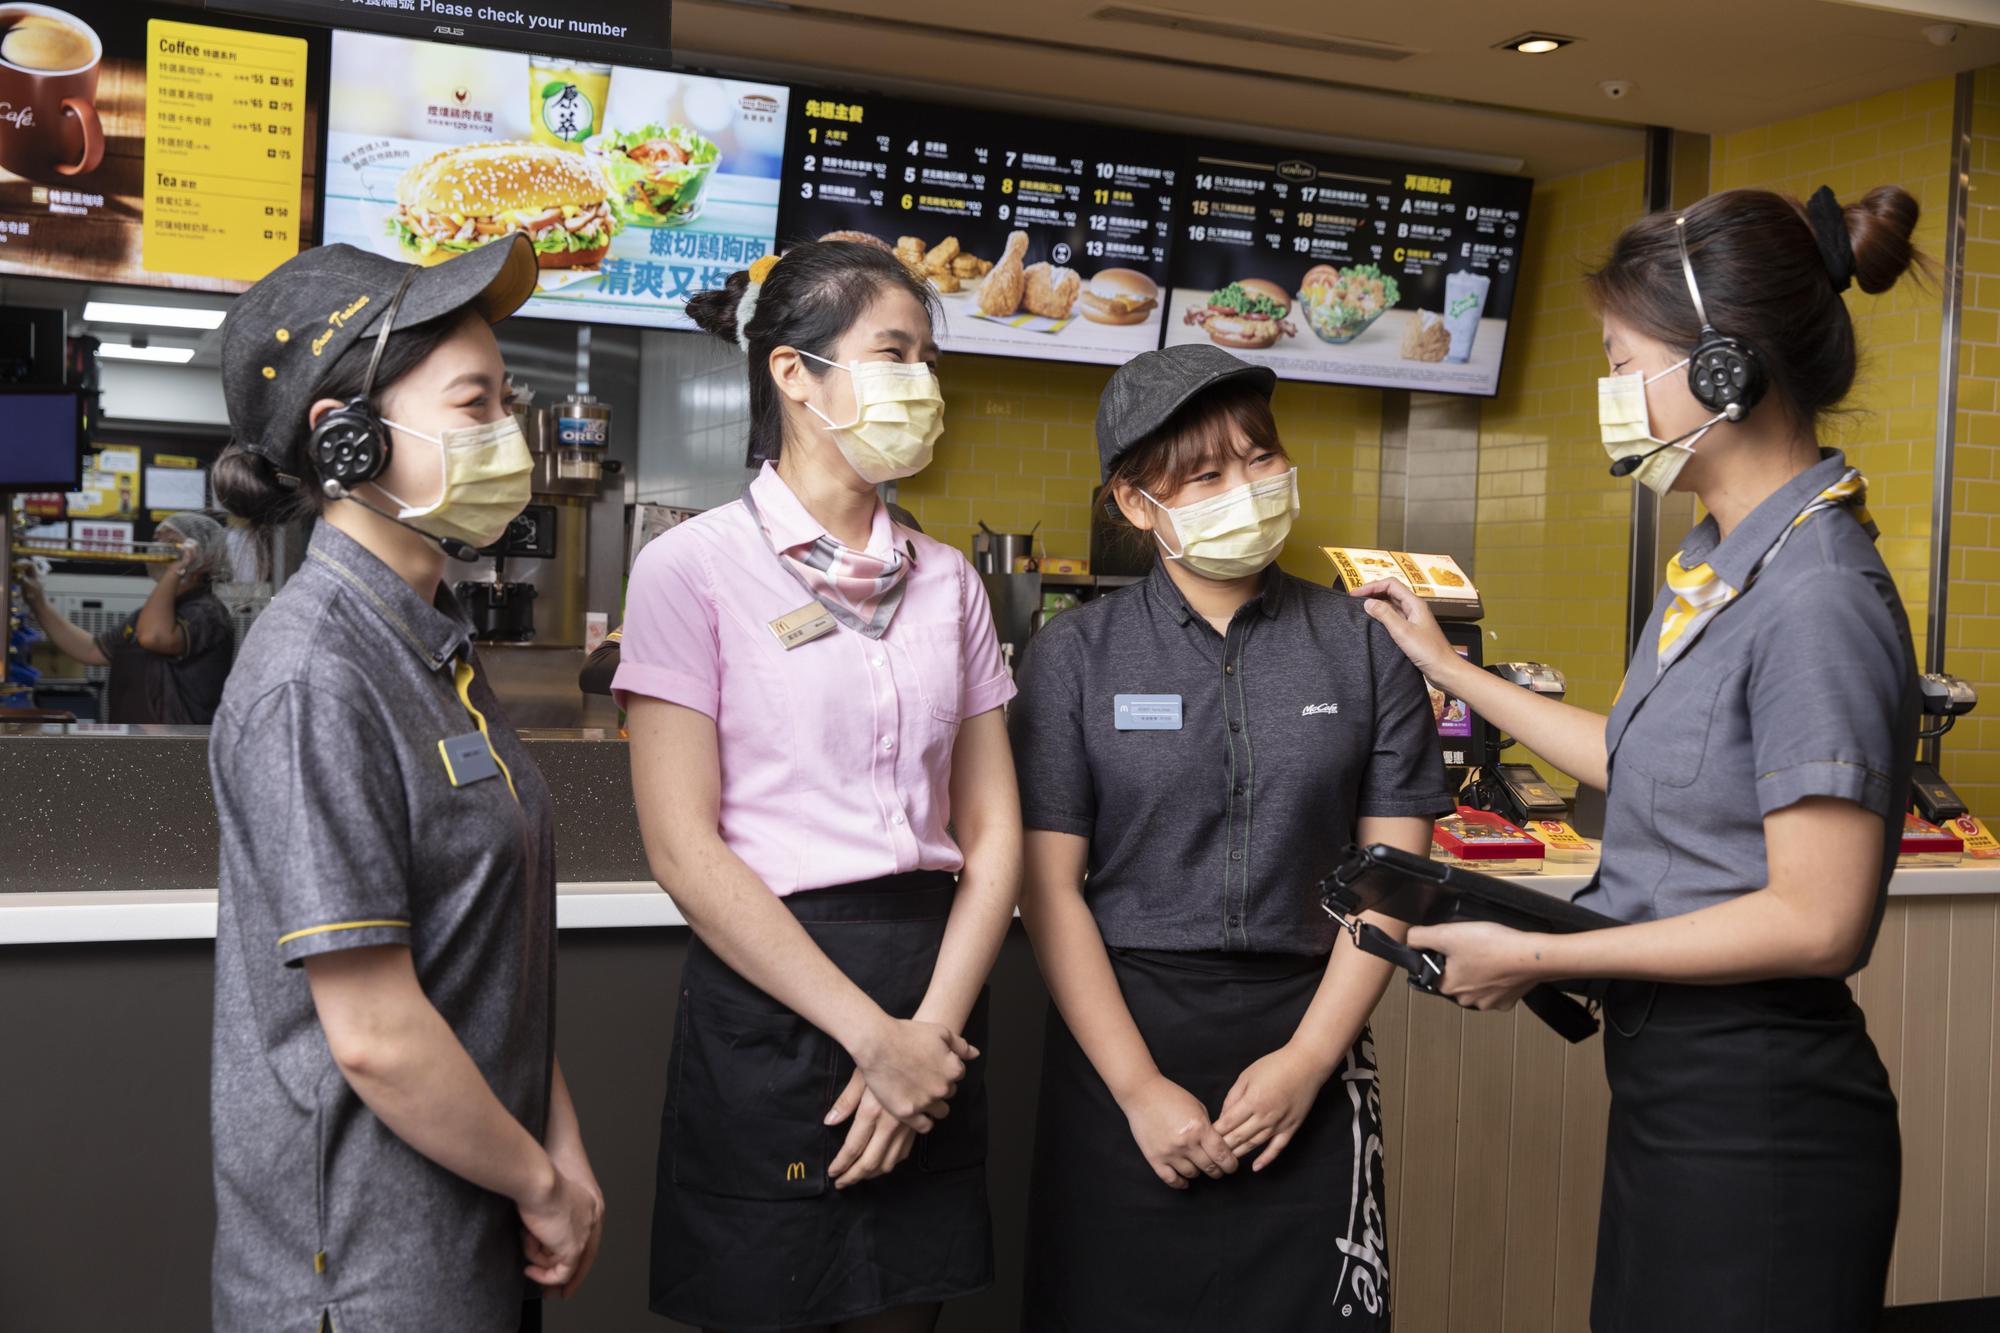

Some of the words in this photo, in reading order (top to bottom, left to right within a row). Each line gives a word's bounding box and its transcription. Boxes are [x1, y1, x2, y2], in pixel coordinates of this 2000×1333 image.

[420, 0, 473, 18] Please
[477, 7, 524, 25] check
[528, 14, 564, 29] your
[568, 18, 627, 38] number
[433, 25, 465, 36] ASUS
[159, 39, 200, 57] Coffee
[805, 99, 864, 123] 先選主餐
[808, 128, 817, 144] 1
[907, 140, 919, 156] 4
[803, 155, 816, 172] 2
[1005, 151, 1017, 167] 7
[904, 167, 916, 183] 5
[1096, 163, 1114, 179] 10
[156, 173, 177, 188] Tea
[1001, 178, 1013, 194] 8
[1195, 174, 1213, 191] 14
[801, 183, 813, 199] 3
[1094, 189, 1109, 205] 11
[1301, 186, 1318, 203] 17
[901, 194, 913, 210] 6
[1192, 200, 1209, 215] 15
[1400, 198, 1412, 213] A
[998, 204, 1010, 220] 9
[1297, 212, 1314, 228] 18
[1465, 205, 1478, 221] D
[1090, 215, 1107, 231] 12
[1397, 223, 1409, 238] B
[1188, 225, 1205, 241] 16
[1086, 240, 1104, 257] 13
[1293, 236, 1310, 252] 19
[1461, 242, 1471, 257] E
[1393, 247, 1406, 262] C
[562, 430, 606, 442] OREO
